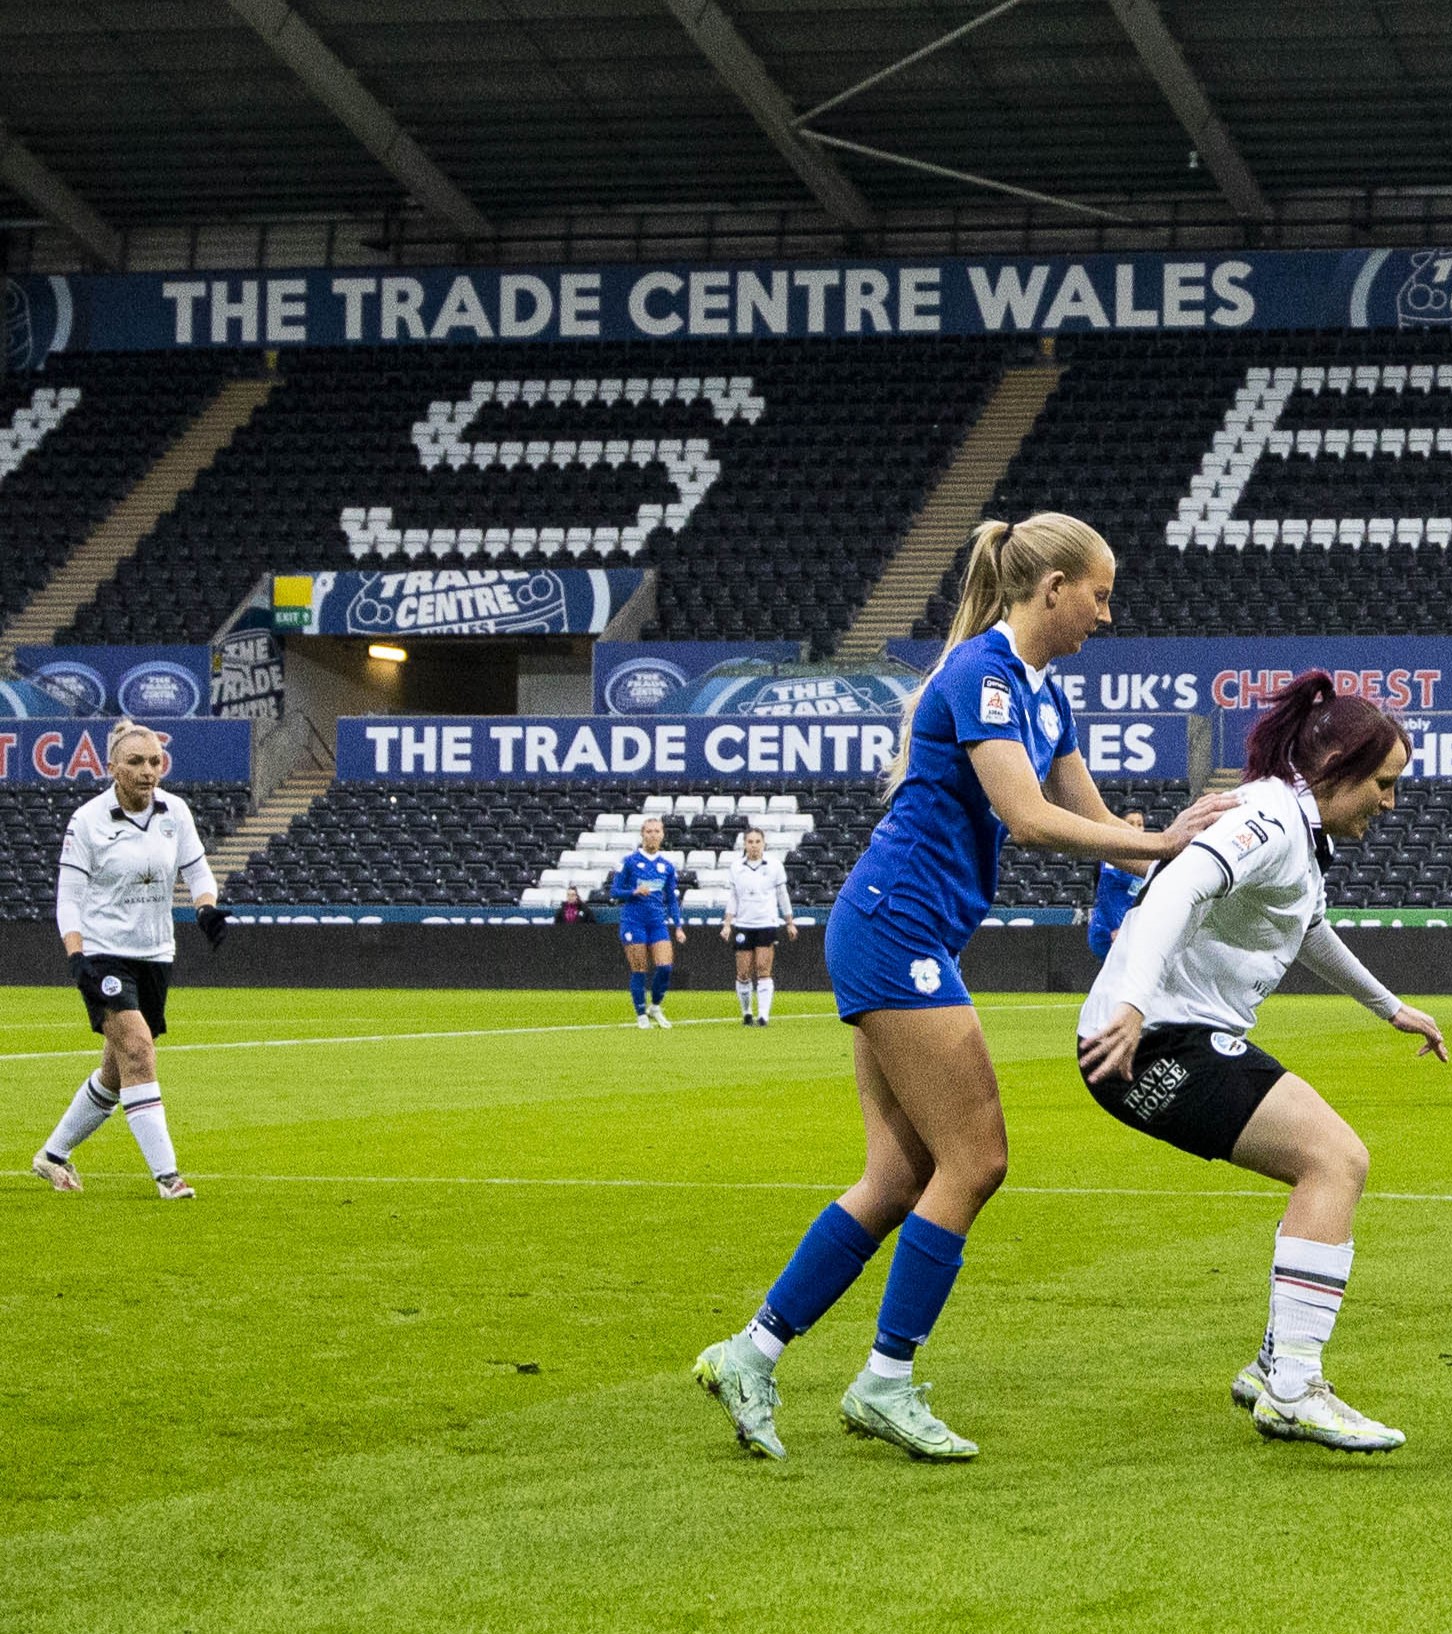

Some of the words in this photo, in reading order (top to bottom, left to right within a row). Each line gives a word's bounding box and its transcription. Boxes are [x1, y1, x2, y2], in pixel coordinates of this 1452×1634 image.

[163, 279, 306, 343] THE
[332, 273, 600, 340] TRADE
[628, 267, 940, 335] CENTRE
[967, 260, 1255, 329] WALES
[275, 611, 299, 622] EXIT
[395, 584, 520, 628] CENTRE
[753, 695, 862, 715] TRADE
[773, 681, 836, 700] THE
[1211, 669, 1441, 709] CHEPEST
[365, 726, 472, 773] THE
[489, 725, 687, 773] TRADE
[704, 724, 896, 773] CENTR
[1124, 1058, 1175, 1109] TRAVEL
[1136, 1064, 1187, 1120] HOUSE
